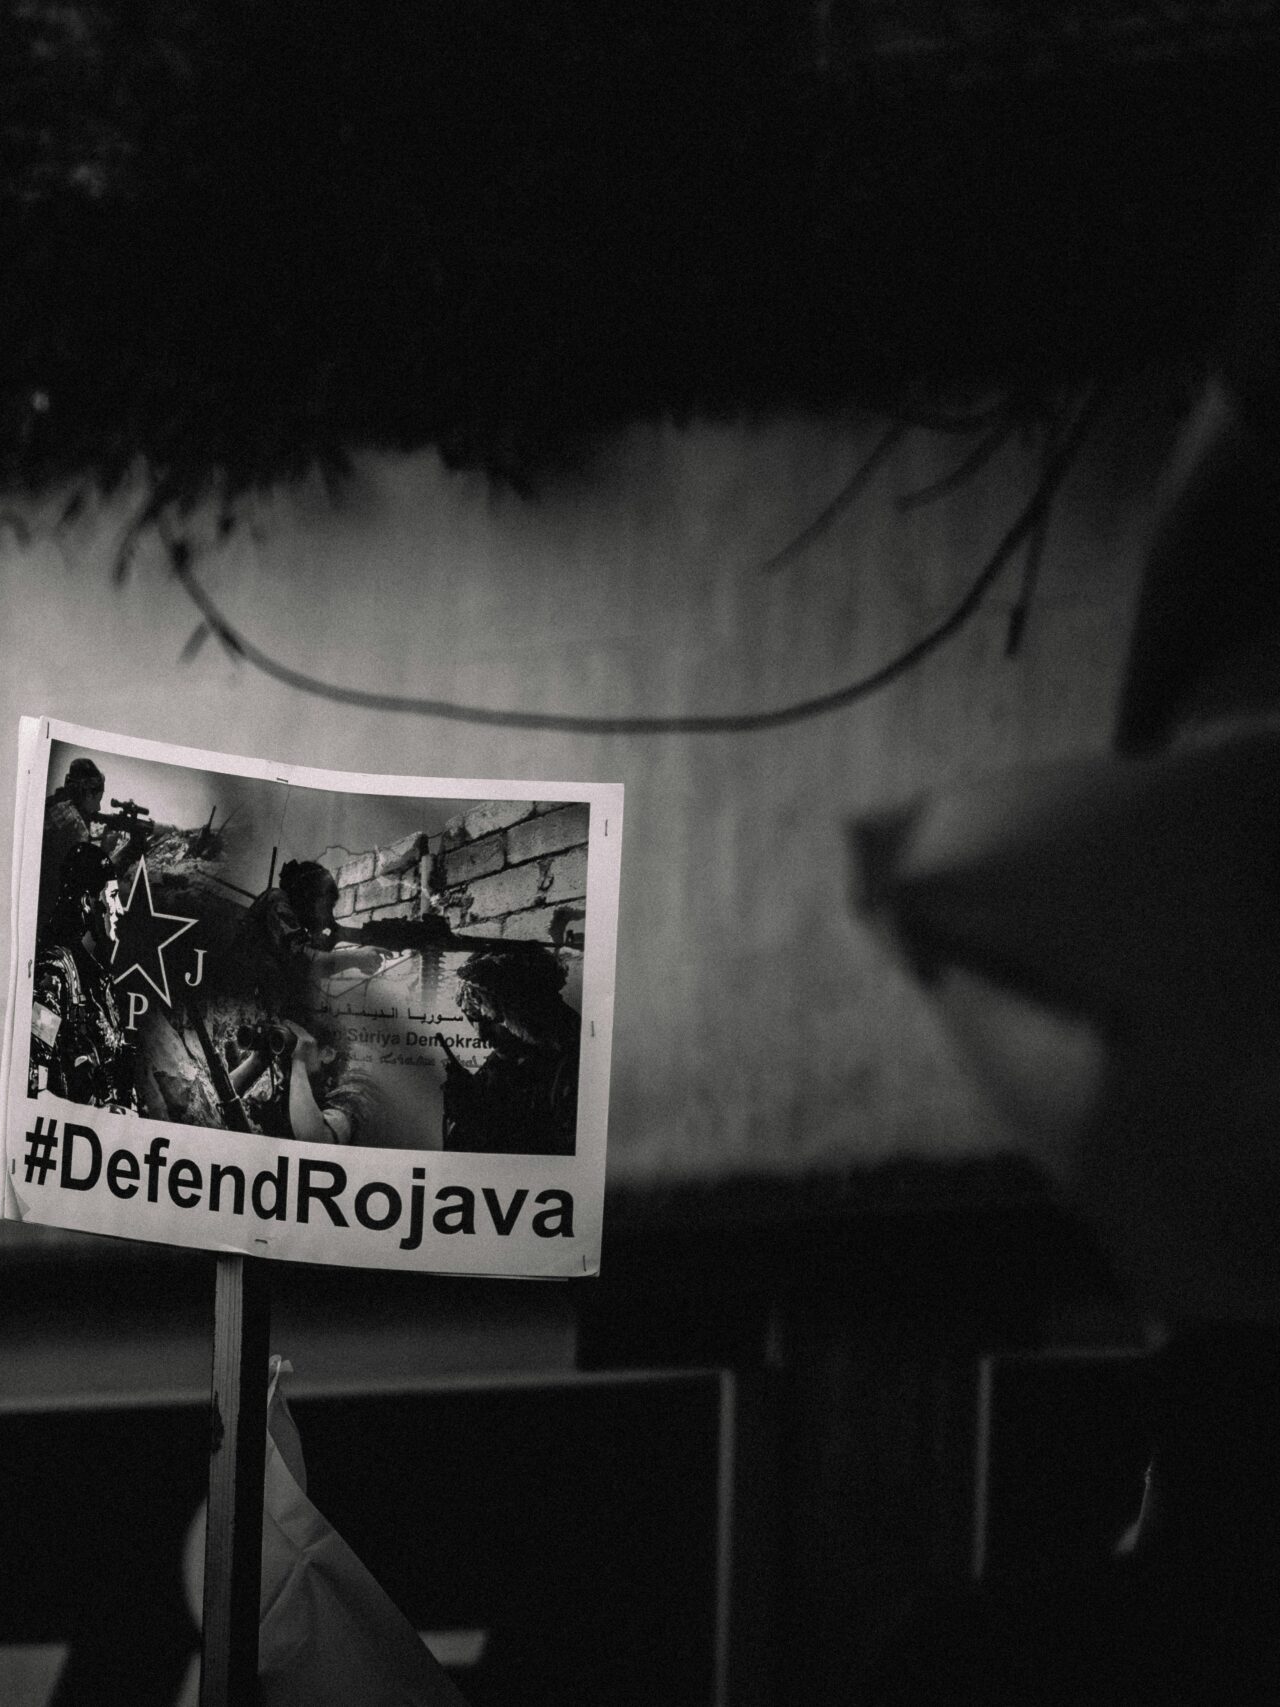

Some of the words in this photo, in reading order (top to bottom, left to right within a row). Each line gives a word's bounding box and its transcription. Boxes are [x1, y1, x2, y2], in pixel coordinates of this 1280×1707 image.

[184, 948, 208, 987] J
[125, 991, 149, 1031] P
[25, 1116, 575, 1250] #DefendRojava
